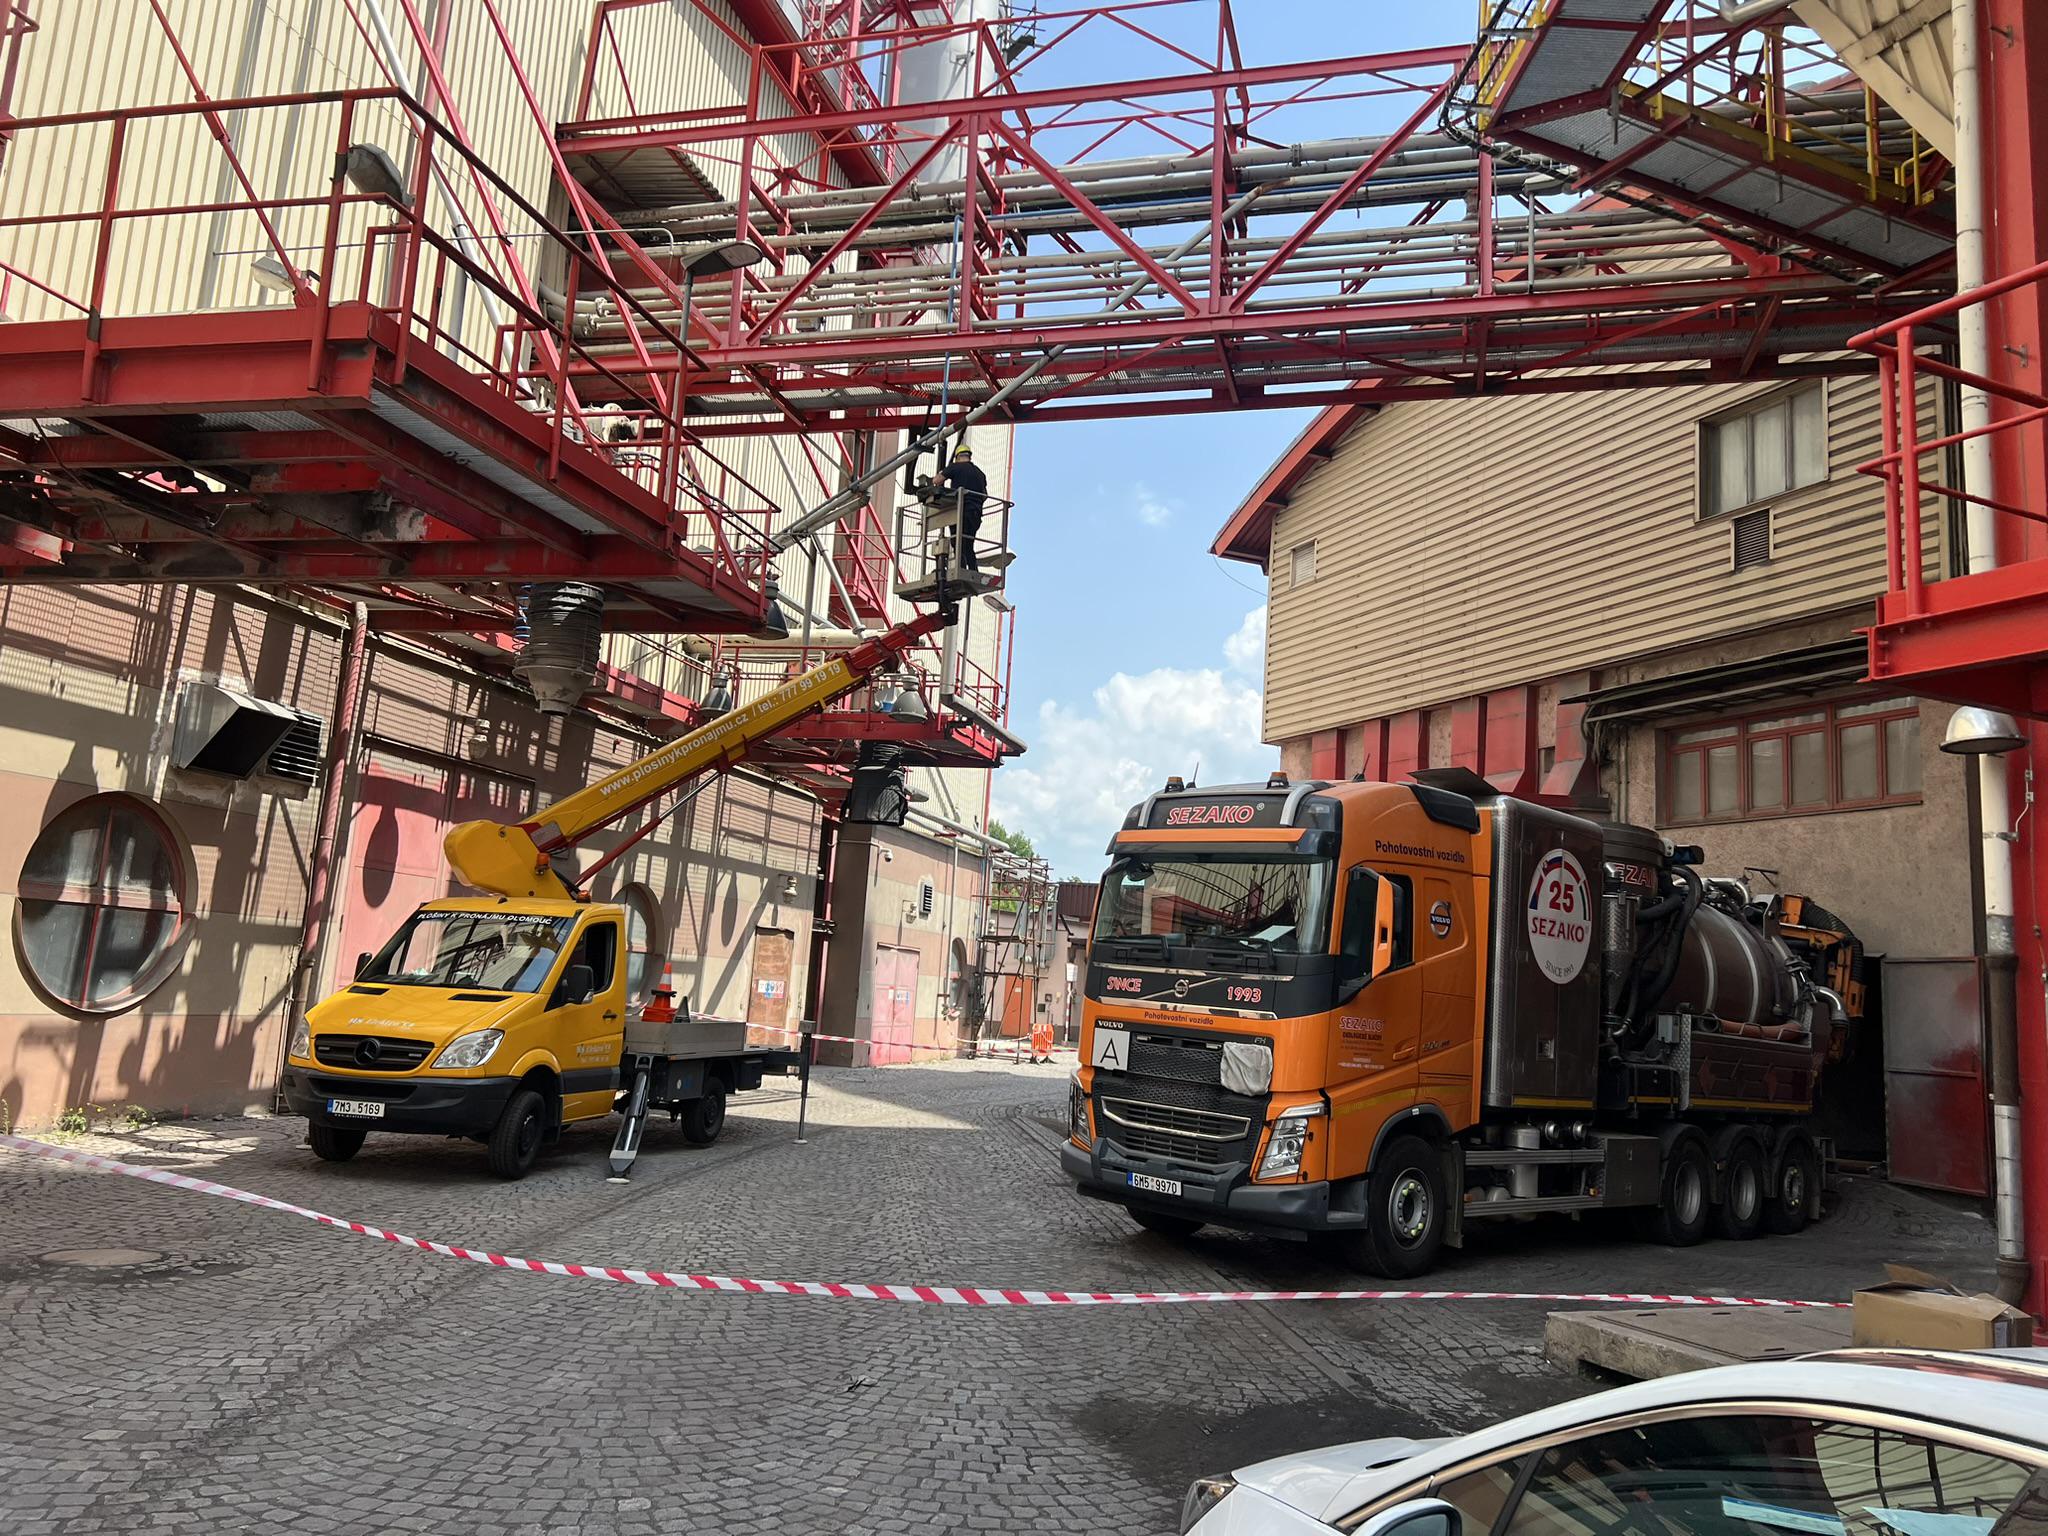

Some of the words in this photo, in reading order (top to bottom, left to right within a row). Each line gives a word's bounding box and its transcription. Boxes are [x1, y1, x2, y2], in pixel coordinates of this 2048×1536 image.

[600, 713, 749, 796] www.plosinykpronajmu.cz
[758, 697, 779, 713] tel.:
[779, 684, 797, 702] 777
[800, 678, 813, 691] 99
[815, 670, 827, 683] 19
[828, 663, 841, 676] 19
[1167, 805, 1255, 825] SEZAKO
[1375, 840, 1435, 858] Pohotovostní
[1437, 851, 1465, 863] vozidlo
[1549, 880, 1575, 913] 25
[451, 911, 457, 919] K
[1431, 915, 1451, 925] VOLVO
[1531, 917, 1585, 942] SEZAKO
[1544, 960, 1562, 978] SINCE
[1106, 976, 1142, 993] SINCE
[1227, 986, 1262, 1003] 1993
[1097, 1020, 1124, 1029] VOLVO
[1189, 1014, 1214, 1025] vozidlo
[1339, 1016, 1383, 1032] SEZAKO
[1100, 1037, 1120, 1066] A
[334, 1101, 351, 1113] 7M3
[357, 1103, 380, 1115] 5169
[1134, 1175, 1150, 1188] 6M5
[1155, 1179, 1177, 1194] 9970
